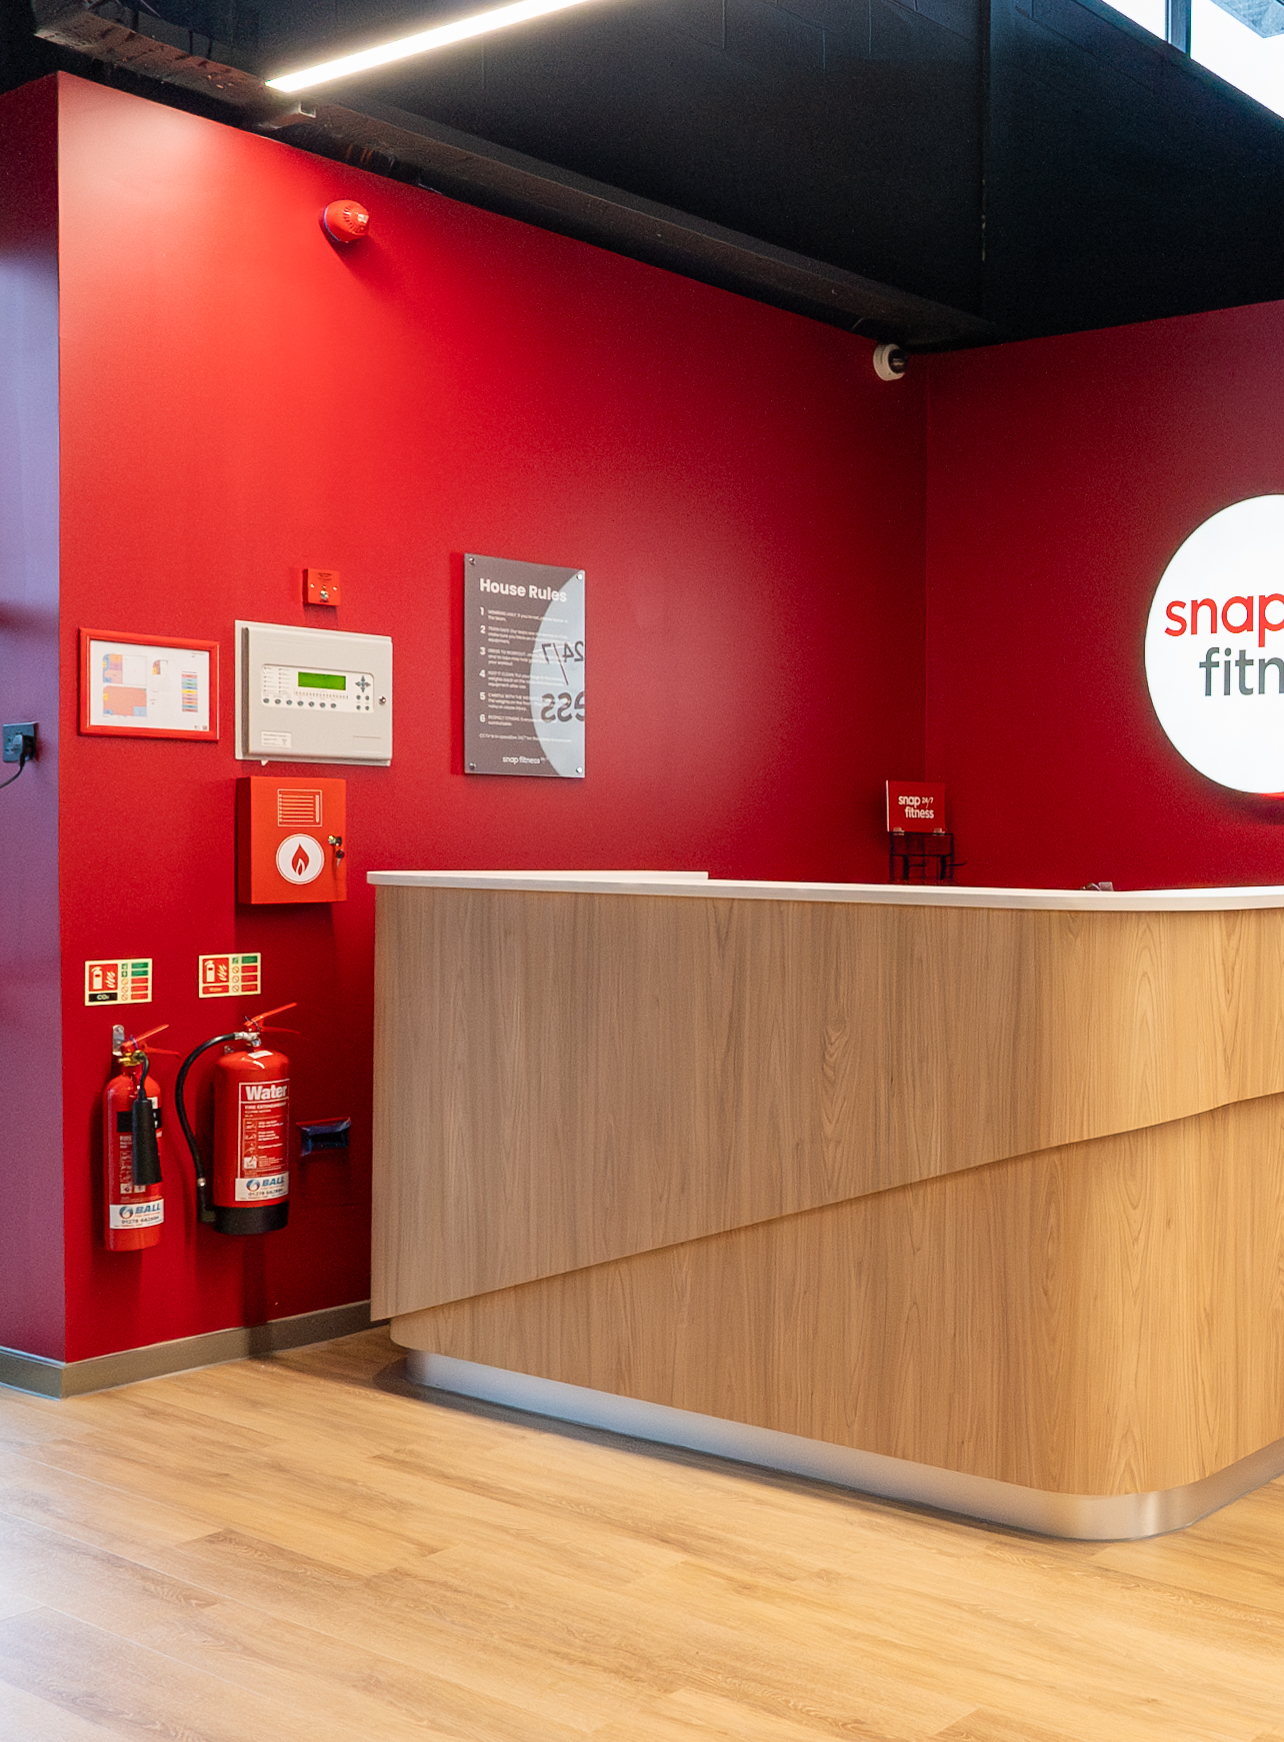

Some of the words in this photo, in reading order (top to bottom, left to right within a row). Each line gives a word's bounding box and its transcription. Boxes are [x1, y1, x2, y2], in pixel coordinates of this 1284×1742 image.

[480, 578, 527, 597] House
[529, 585, 567, 602] Rules
[480, 606, 485, 616] 1
[480, 625, 486, 634] 2
[480, 646, 486, 656] 3
[479, 669, 486, 678] 4
[480, 691, 486, 701] 5
[480, 713, 486, 723] 6
[502, 756, 519, 765] snap
[519, 755, 541, 765] fitness
[898, 795, 921, 809] snap
[904, 806, 935, 819] fitness
[245, 1084, 288, 1101] Water
[262, 1176, 285, 1187] BALL
[135, 1203, 161, 1214] BALL
